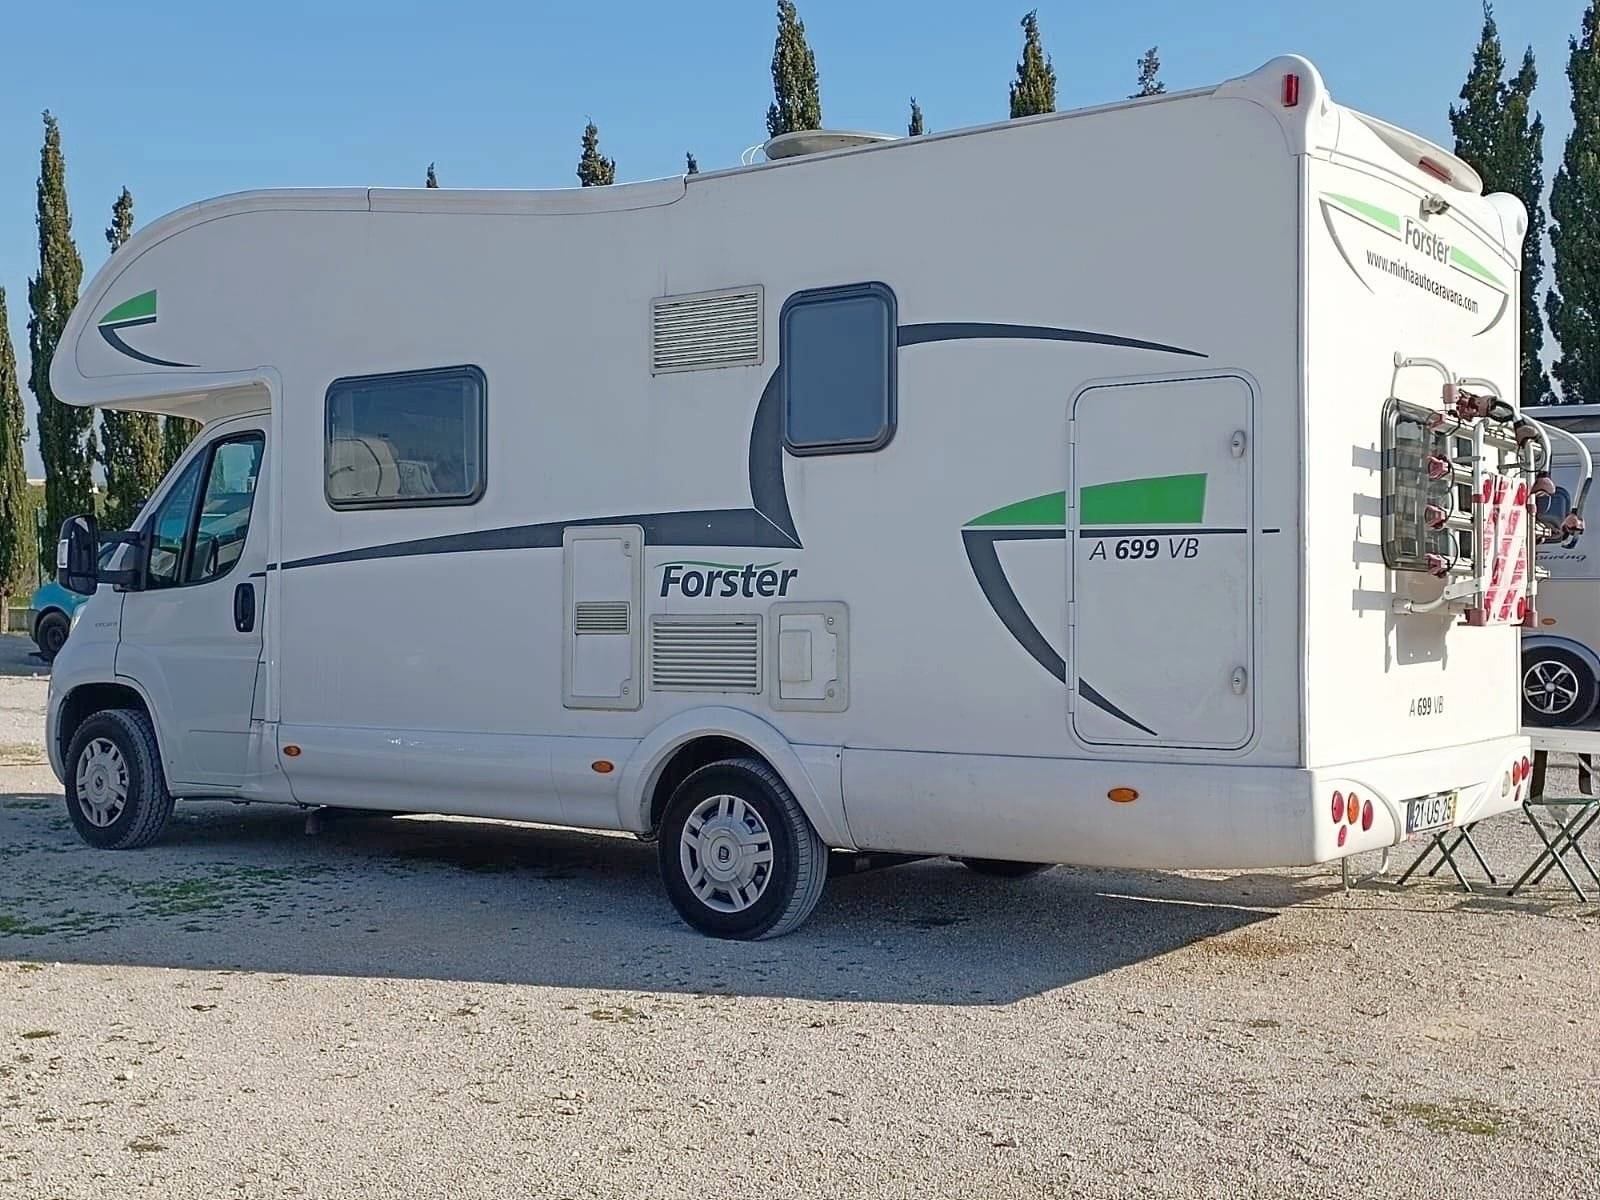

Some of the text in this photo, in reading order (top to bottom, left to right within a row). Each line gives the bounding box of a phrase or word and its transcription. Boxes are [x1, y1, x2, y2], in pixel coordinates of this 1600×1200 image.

[1405, 218, 1450, 265] Forster
[1366, 249, 1479, 314] www.minhaautocaravana.com
[1089, 537, 1200, 561] A 699 VB
[660, 563, 798, 598] Forster
[1408, 695, 1444, 717] A 699 VB
